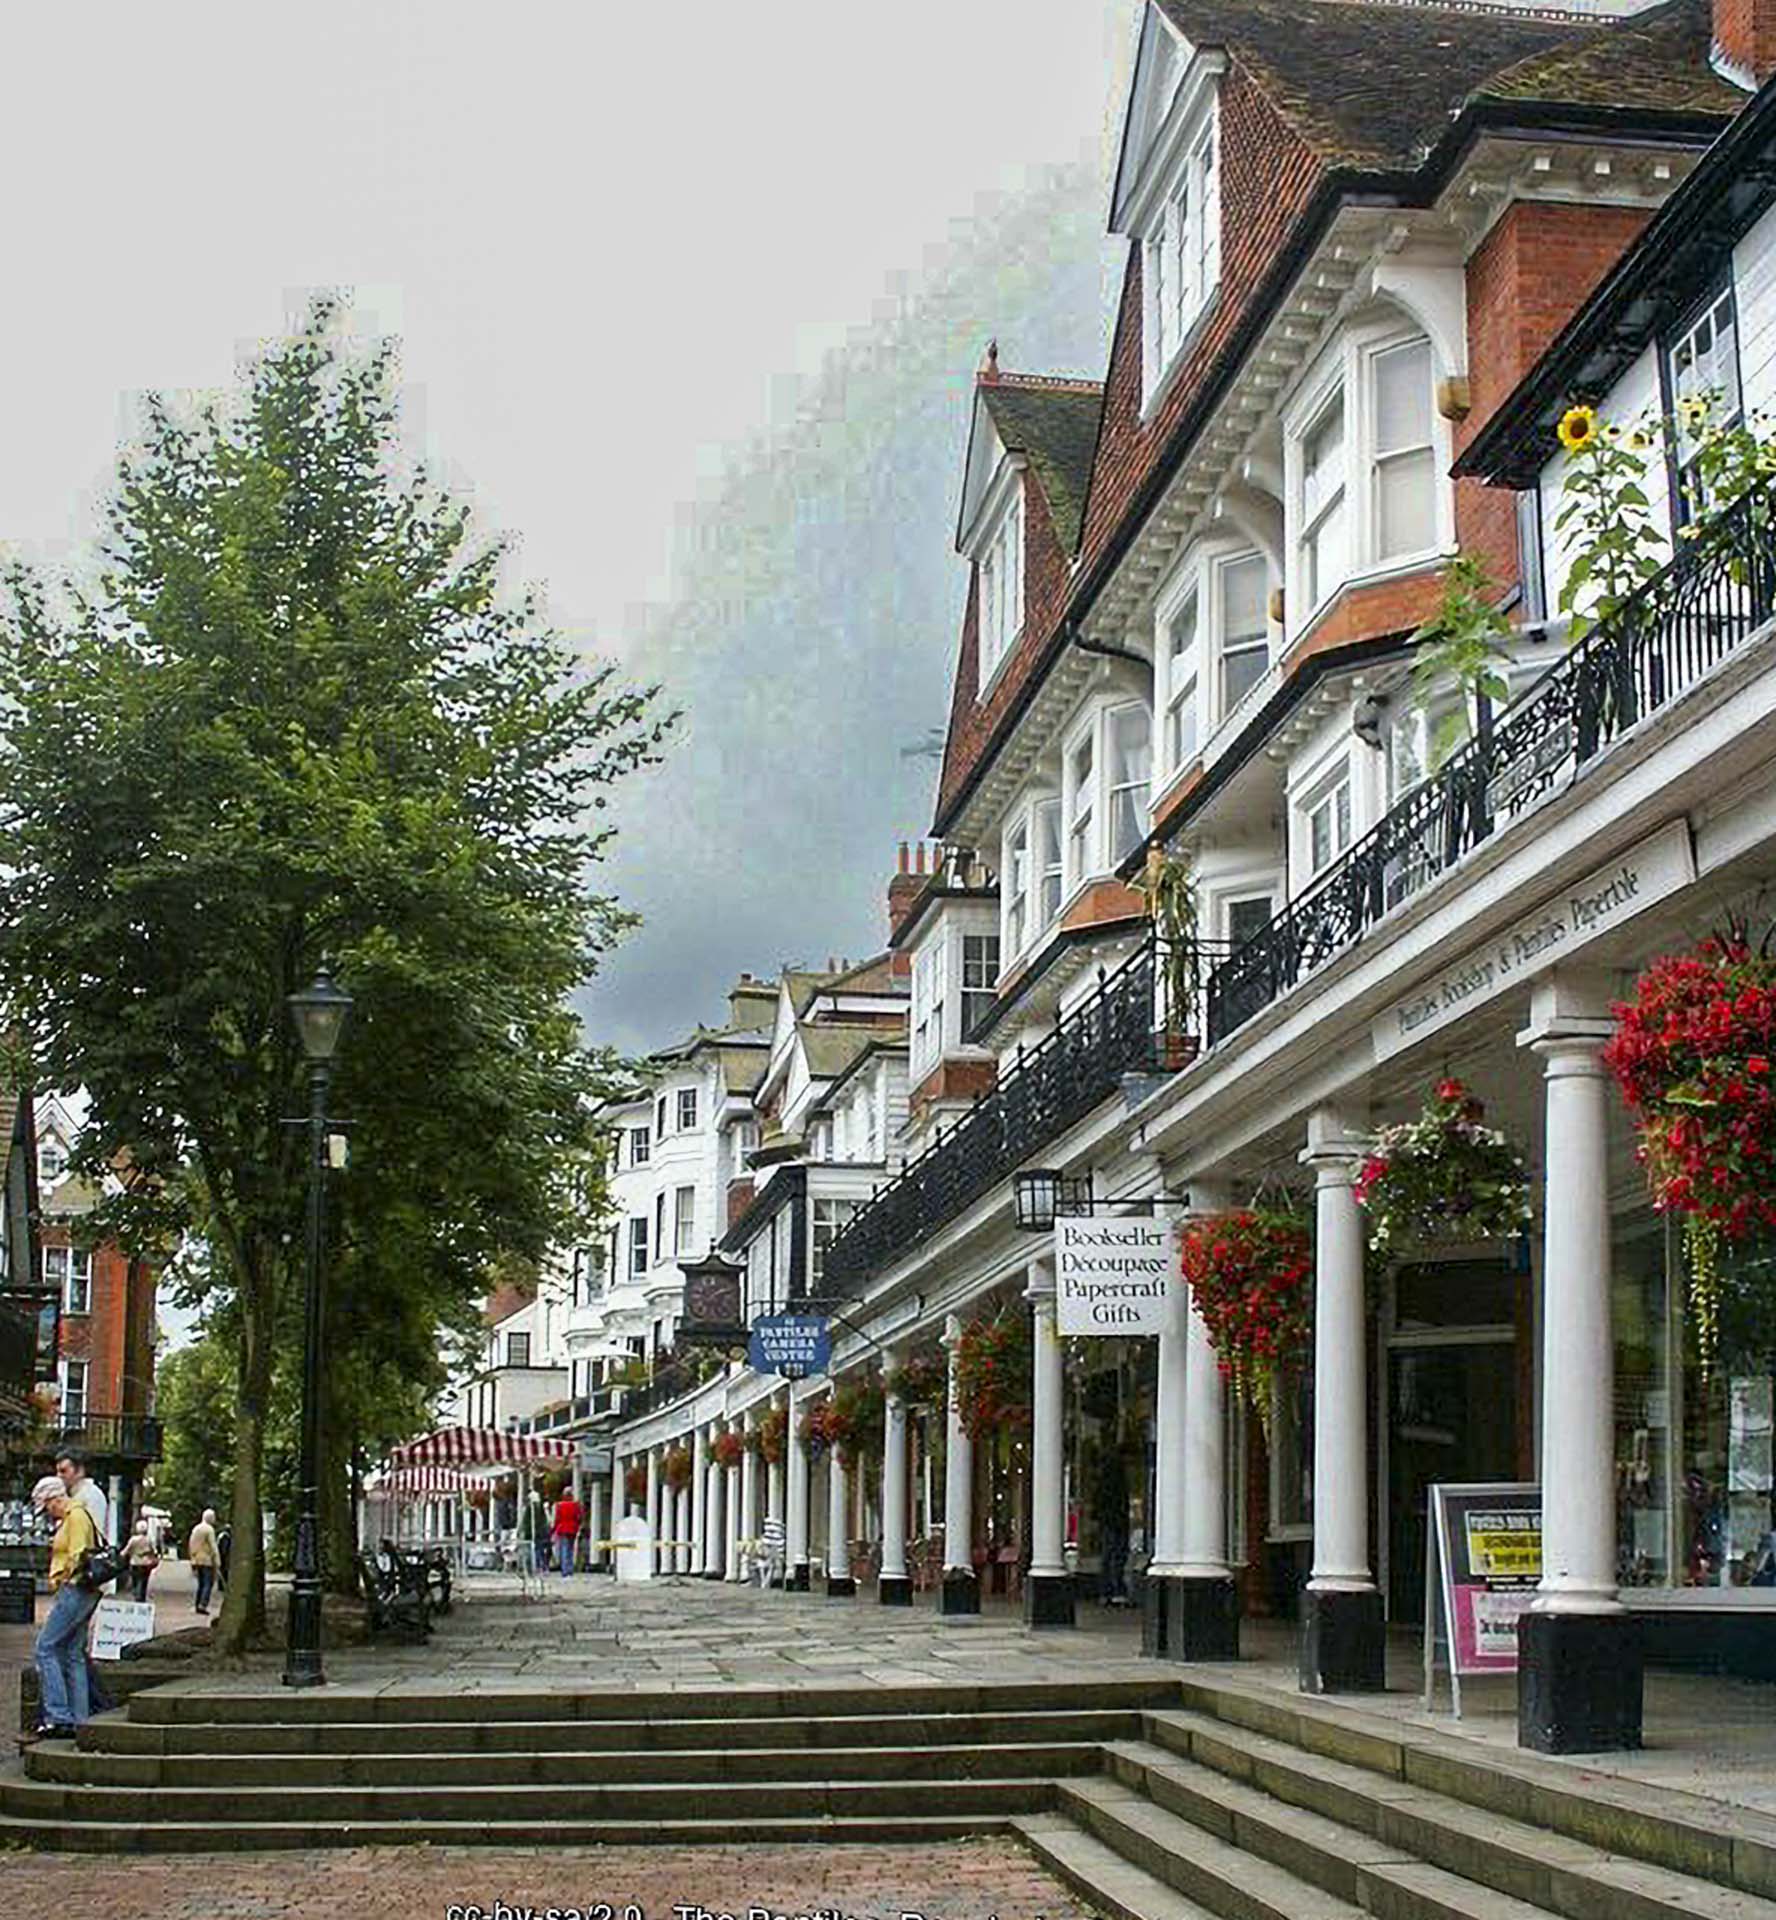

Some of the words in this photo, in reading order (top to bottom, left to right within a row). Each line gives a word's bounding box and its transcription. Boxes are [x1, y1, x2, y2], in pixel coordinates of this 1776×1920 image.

[1063, 1227, 1168, 1247] Bookseller
[1064, 1278, 1166, 1303] Papercraft
[1092, 1304, 1141, 1324] Gifts
[762, 1338, 816, 1349] CAMERA
